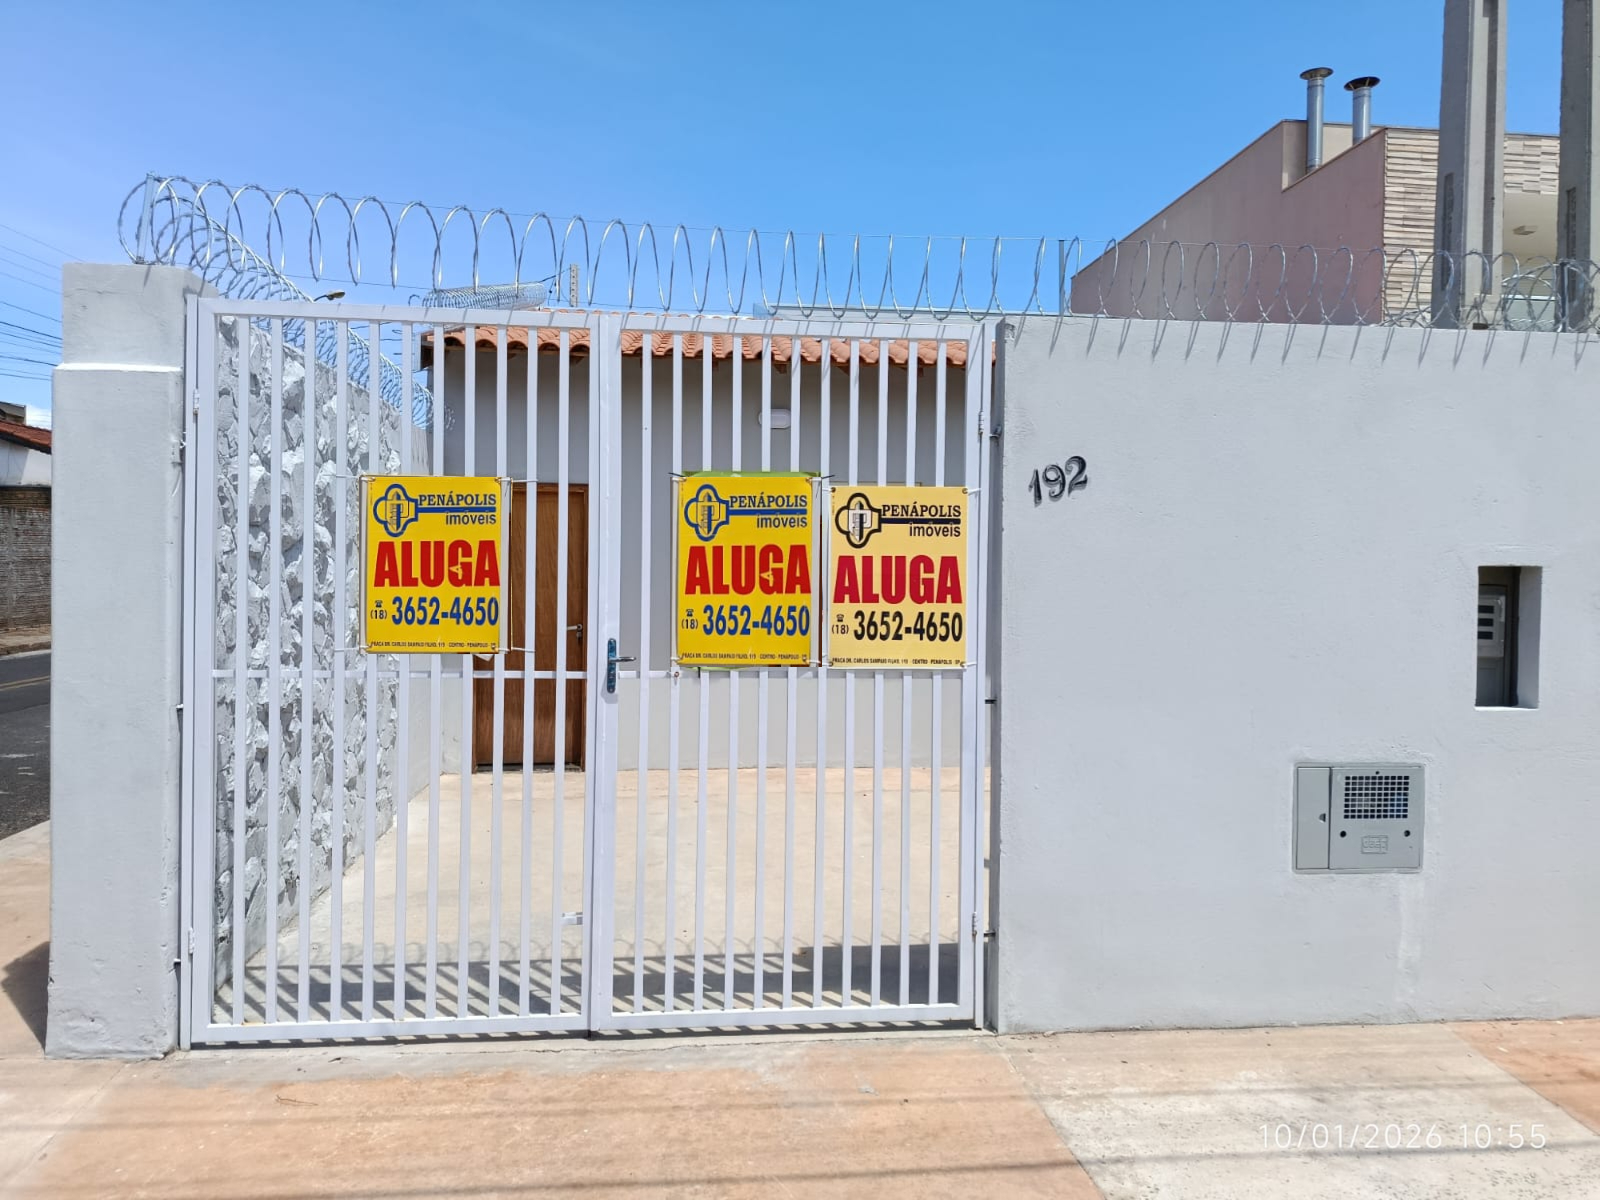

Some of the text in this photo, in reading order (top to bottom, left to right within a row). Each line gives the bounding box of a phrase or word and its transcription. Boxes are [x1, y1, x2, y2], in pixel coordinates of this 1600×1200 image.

[1028, 455, 1088, 508] 192
[418, 491, 497, 506] PENÁPOLIS
[729, 491, 808, 508] PENÁPOLIS
[881, 501, 961, 518] PENÁPOLIS
[446, 510, 497, 525] imóveis
[756, 513, 808, 529] imóveis
[908, 522, 961, 537] imóveis
[373, 539, 501, 588] ALUGA
[684, 543, 812, 596] ALUGA
[832, 554, 963, 605] ALUGA
[370, 596, 499, 626] (18) 3652-4650
[681, 604, 810, 637] (18) 3652-4650
[831, 610, 963, 642] (18) 3652-4650
